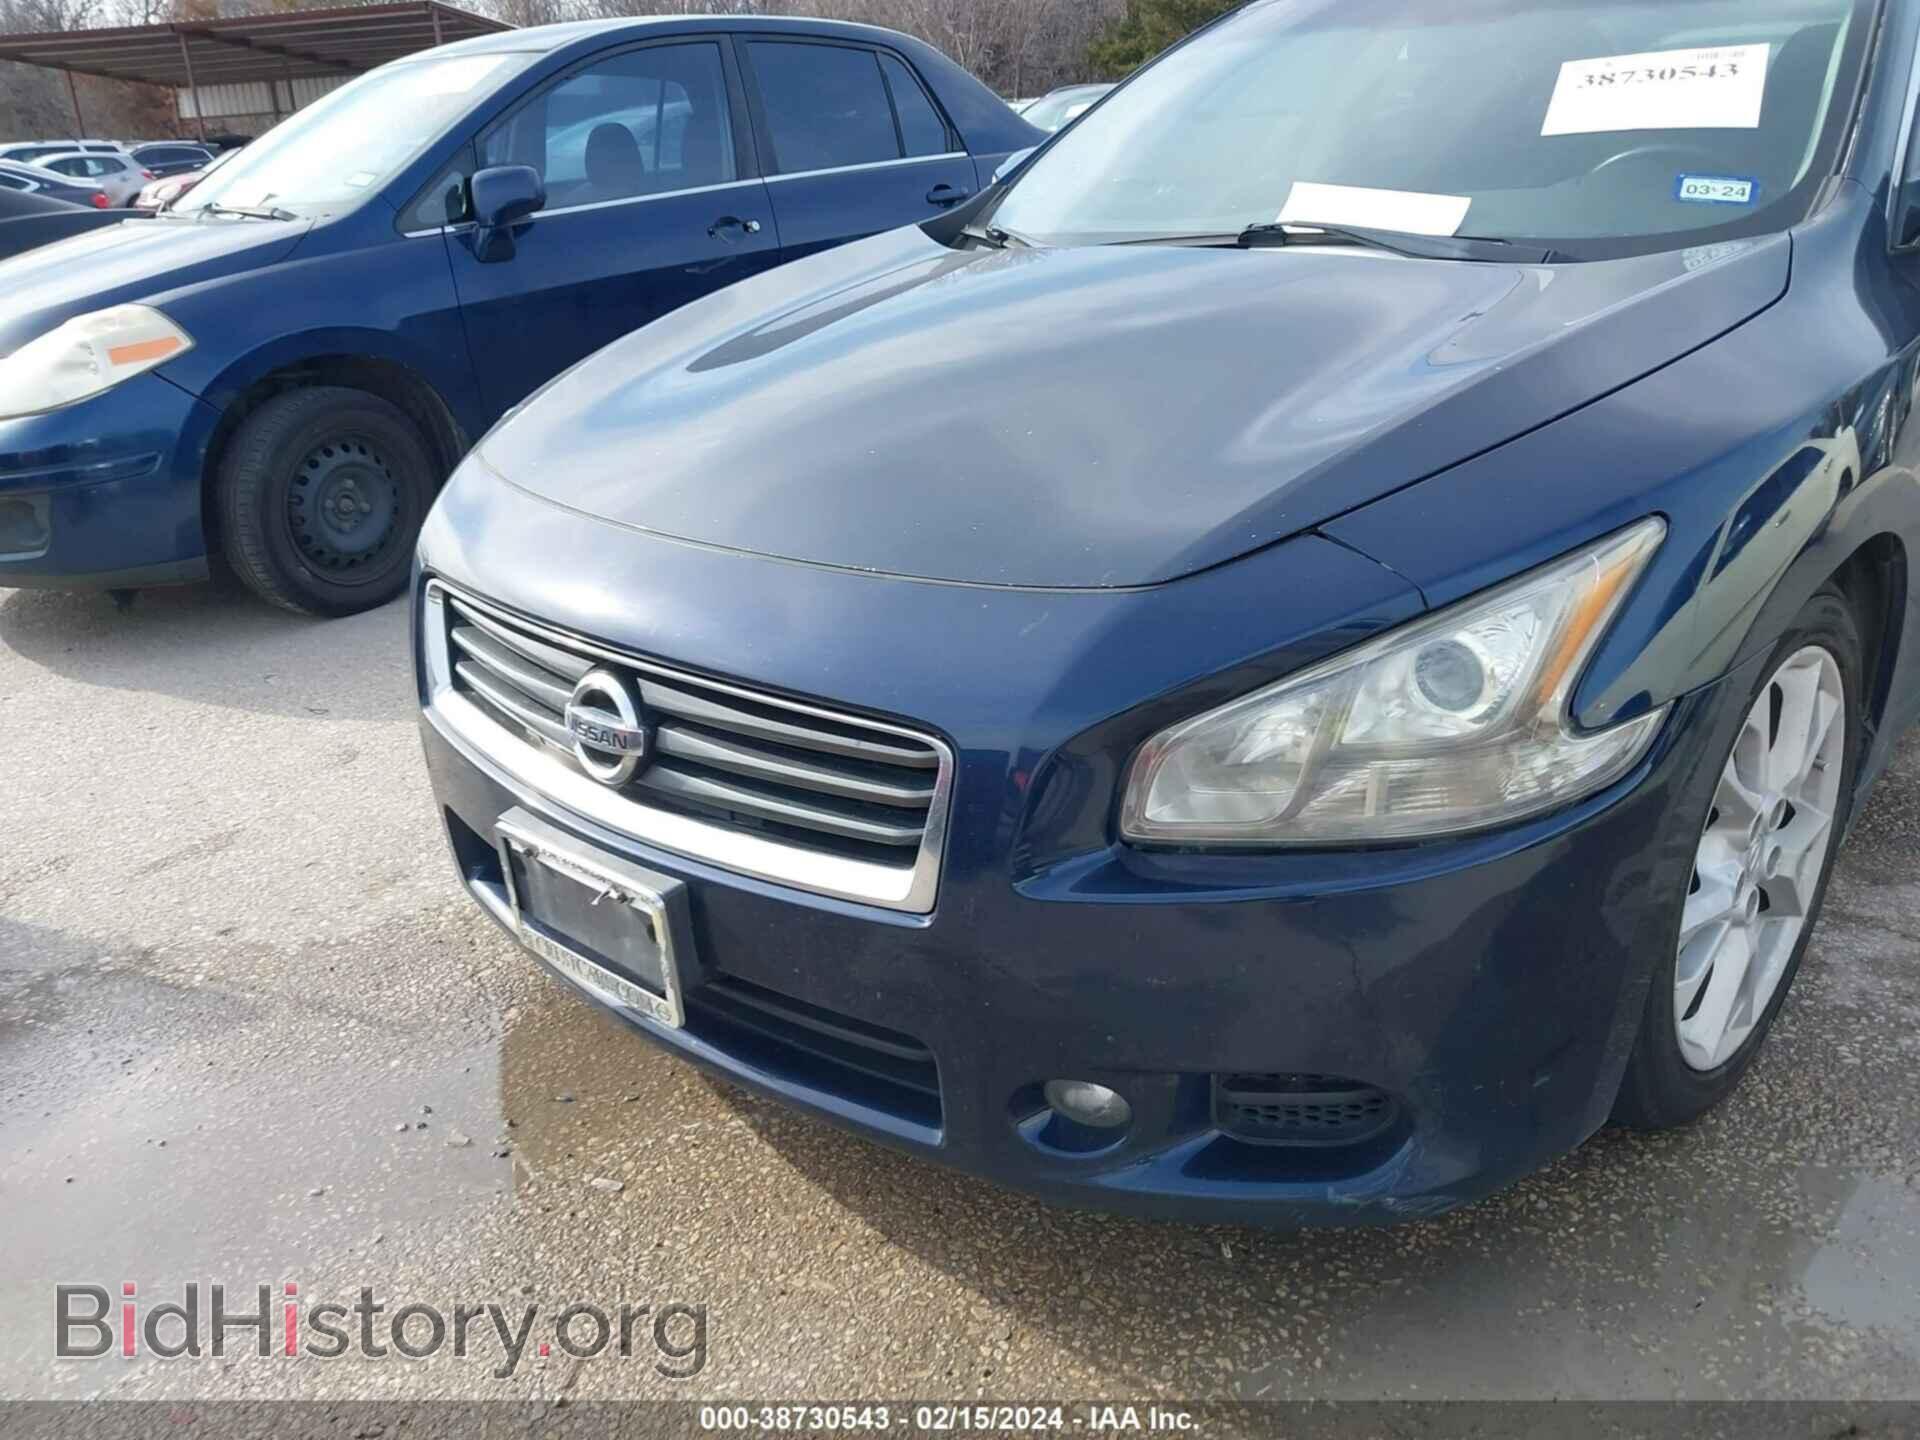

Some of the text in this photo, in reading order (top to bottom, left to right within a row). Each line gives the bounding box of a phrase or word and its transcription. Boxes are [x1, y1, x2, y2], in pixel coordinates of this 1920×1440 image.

[1577, 63, 1740, 88] 38730543
[1686, 184, 1746, 197] 03 24
